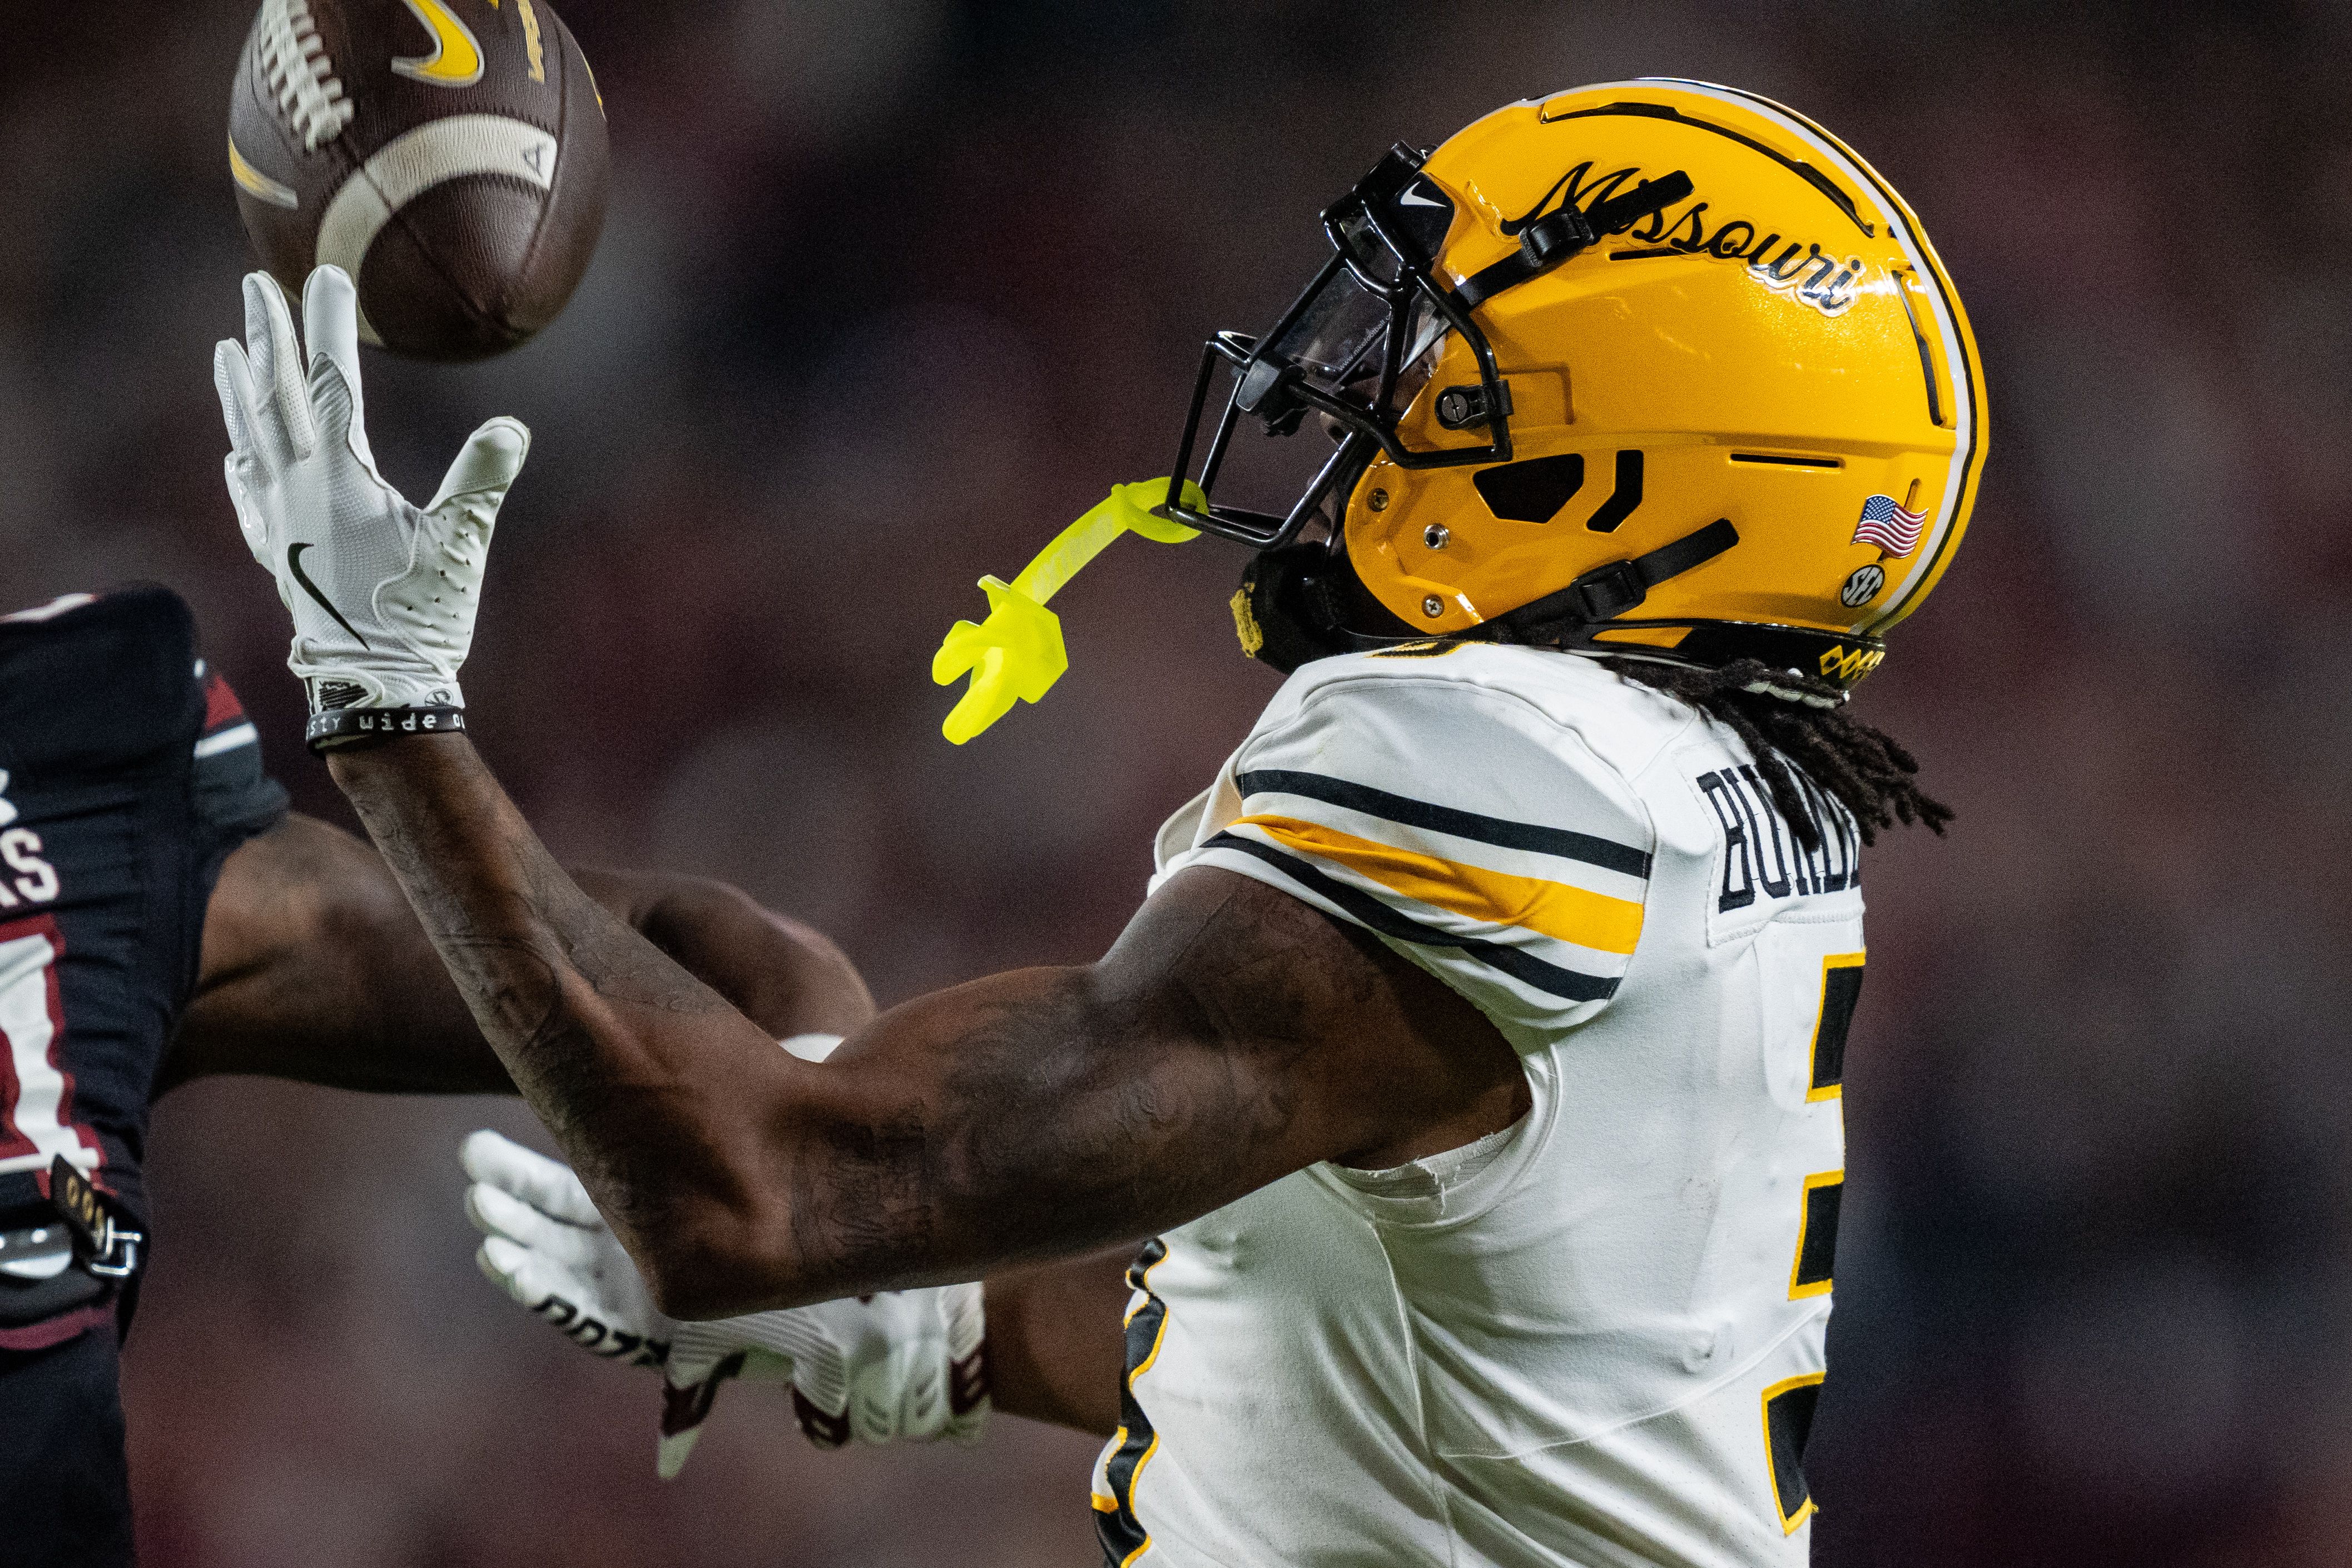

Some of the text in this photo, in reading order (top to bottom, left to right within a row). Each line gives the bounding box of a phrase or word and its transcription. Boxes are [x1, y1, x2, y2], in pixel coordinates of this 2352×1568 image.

[1501, 161, 1862, 311] Mssouri
[1337, 314, 1391, 371] www.nikefootball.c
[1841, 564, 1885, 608] SEC
[1696, 763, 1861, 914] BUD
